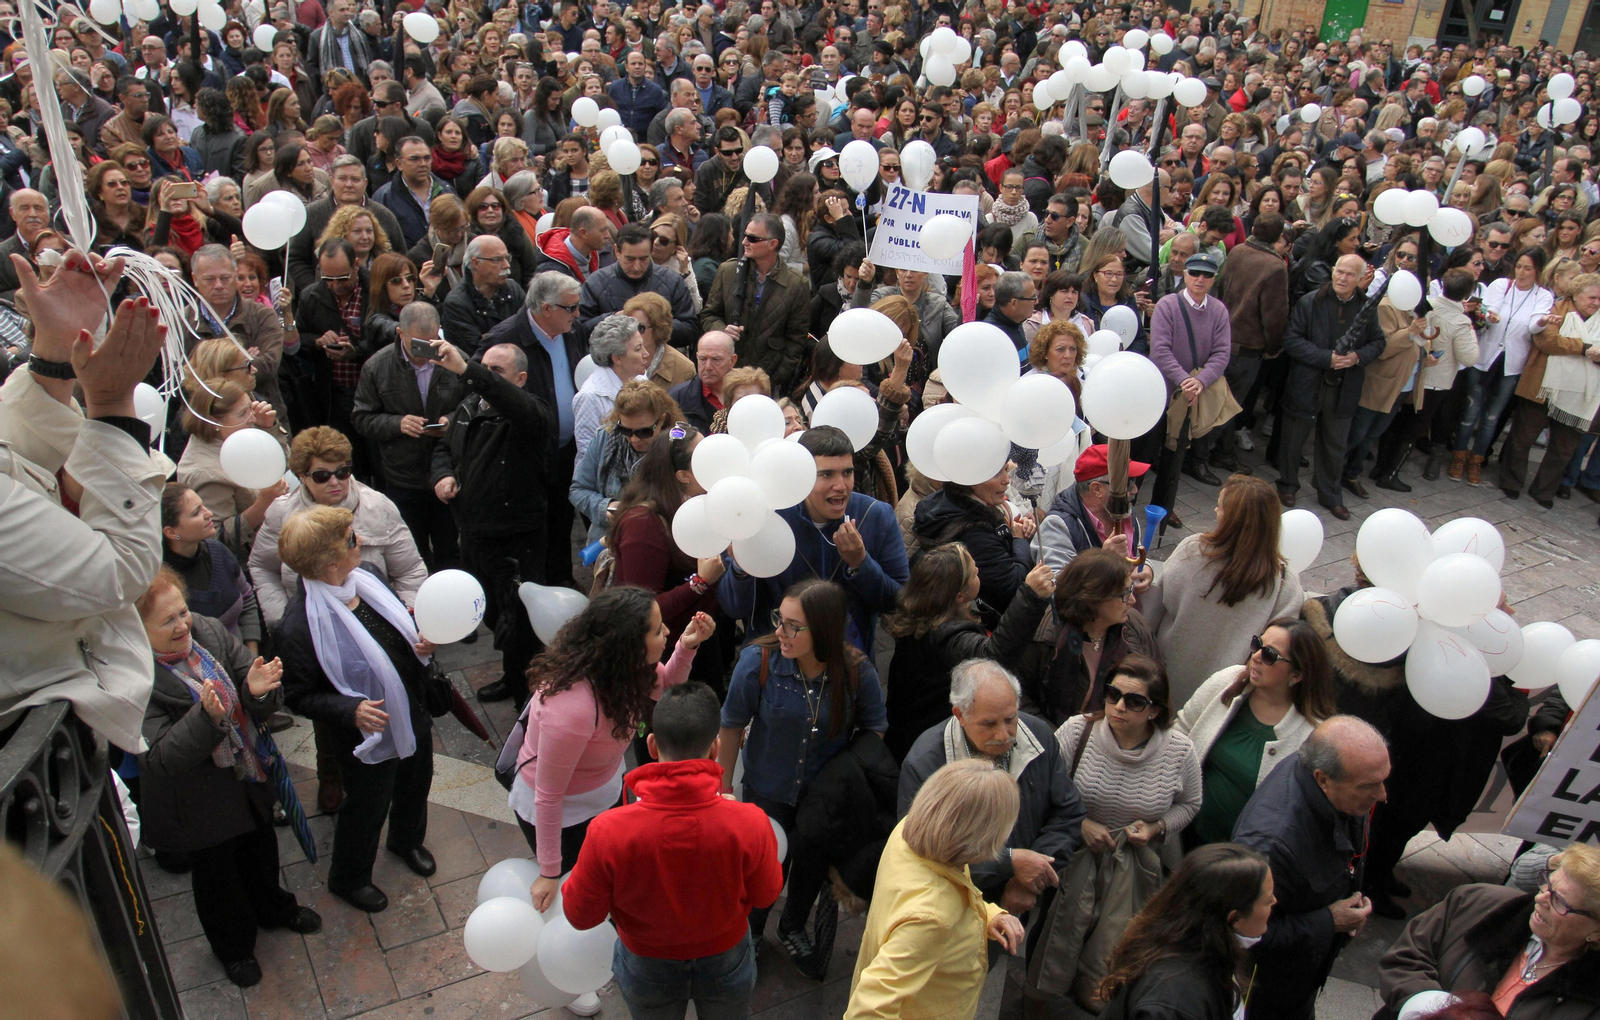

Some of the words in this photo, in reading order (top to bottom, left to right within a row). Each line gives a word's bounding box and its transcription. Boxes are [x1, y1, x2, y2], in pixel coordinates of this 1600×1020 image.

[888, 186, 926, 215] 27-N
[882, 217, 895, 227] POR
[888, 235, 921, 249] PÚBLIC
[880, 248, 927, 264] HOSPITAL
[933, 257, 963, 268] RIOTIN
